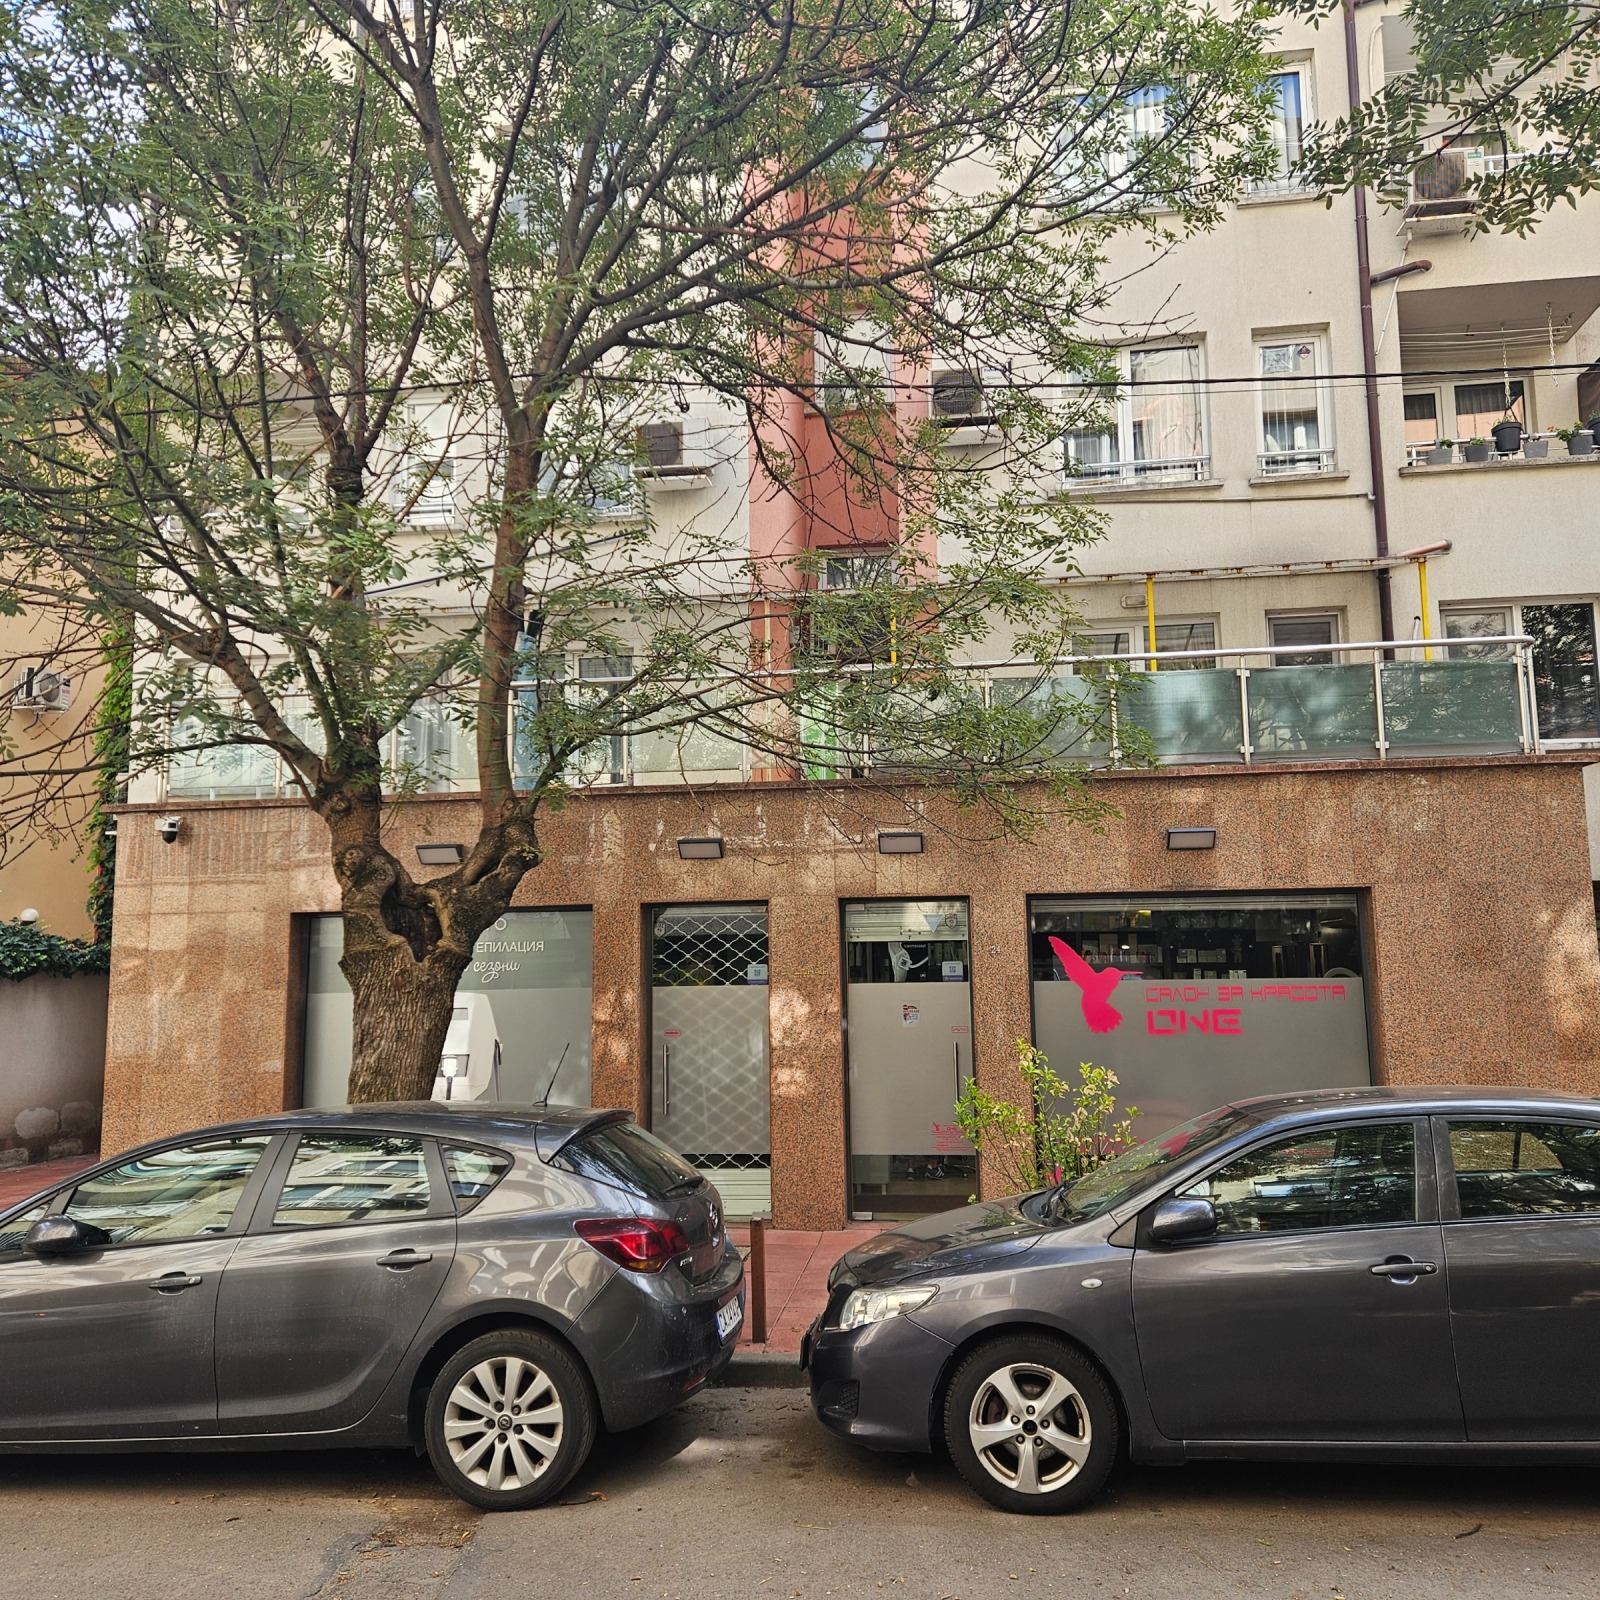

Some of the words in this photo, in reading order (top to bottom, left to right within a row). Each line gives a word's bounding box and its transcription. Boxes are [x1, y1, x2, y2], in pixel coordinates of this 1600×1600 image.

[476, 941, 544, 953] ЕПИЛАЦИЯ
[473, 961, 520, 983] сезони
[1145, 986, 1210, 1002] САЛОН
[1217, 986, 1244, 1002] ЗА
[1251, 984, 1346, 1001] КРАСОТА
[1147, 1008, 1243, 1035] ONE
